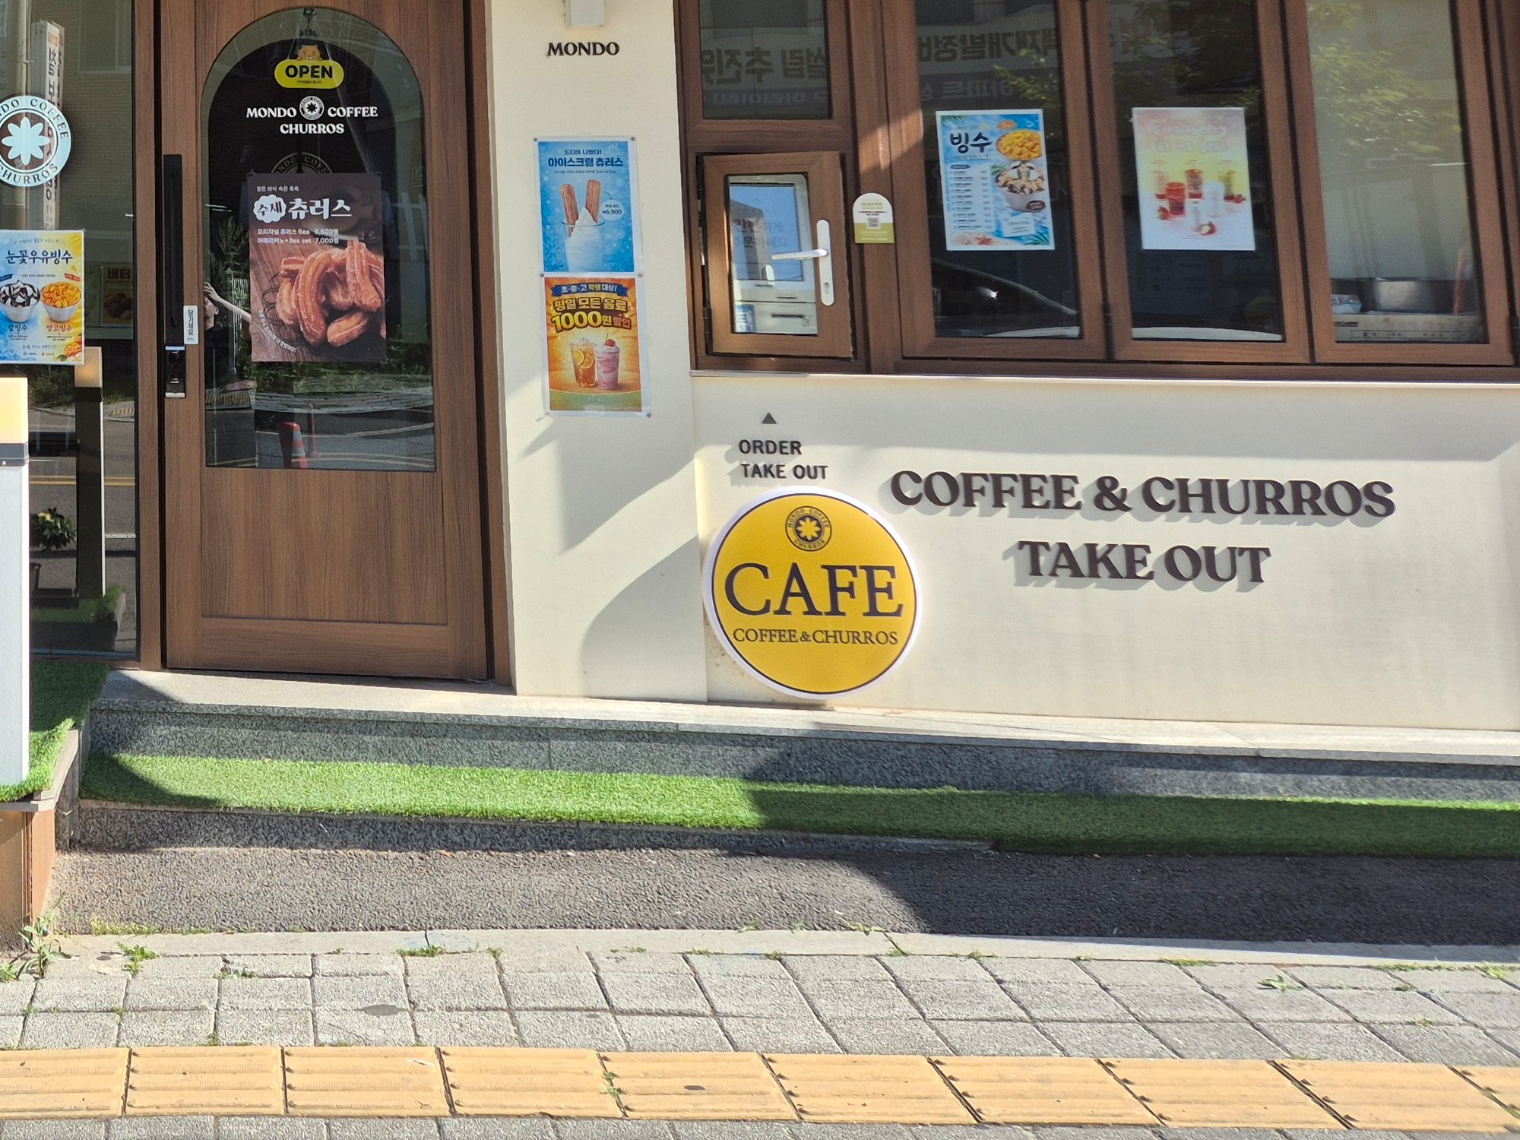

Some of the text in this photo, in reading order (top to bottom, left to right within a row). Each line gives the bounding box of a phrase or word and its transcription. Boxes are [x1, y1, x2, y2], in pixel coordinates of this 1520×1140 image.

[547, 41, 620, 57] MONDO
[285, 64, 333, 79] OPEN
[30, 98, 69, 140] COFFEE
[246, 107, 297, 118] MONDO
[328, 106, 378, 118] COFFEE
[280, 123, 345, 134] CHURROS
[950, 131, 992, 154] 빙수
[258, 198, 352, 220] 수제 츄러스
[6, 249, 73, 265] 눈꽃우유빙수
[554, 297, 628, 312] 평일 모든 음료
[551, 310, 612, 333] 1000원
[738, 439, 803, 455] ORDER
[740, 463, 828, 479] TAKE OUT
[891, 470, 1397, 519] COFFEE & CHURROS
[1017, 540, 1272, 585] TAKE OUT
[724, 562, 904, 618] CAFE
